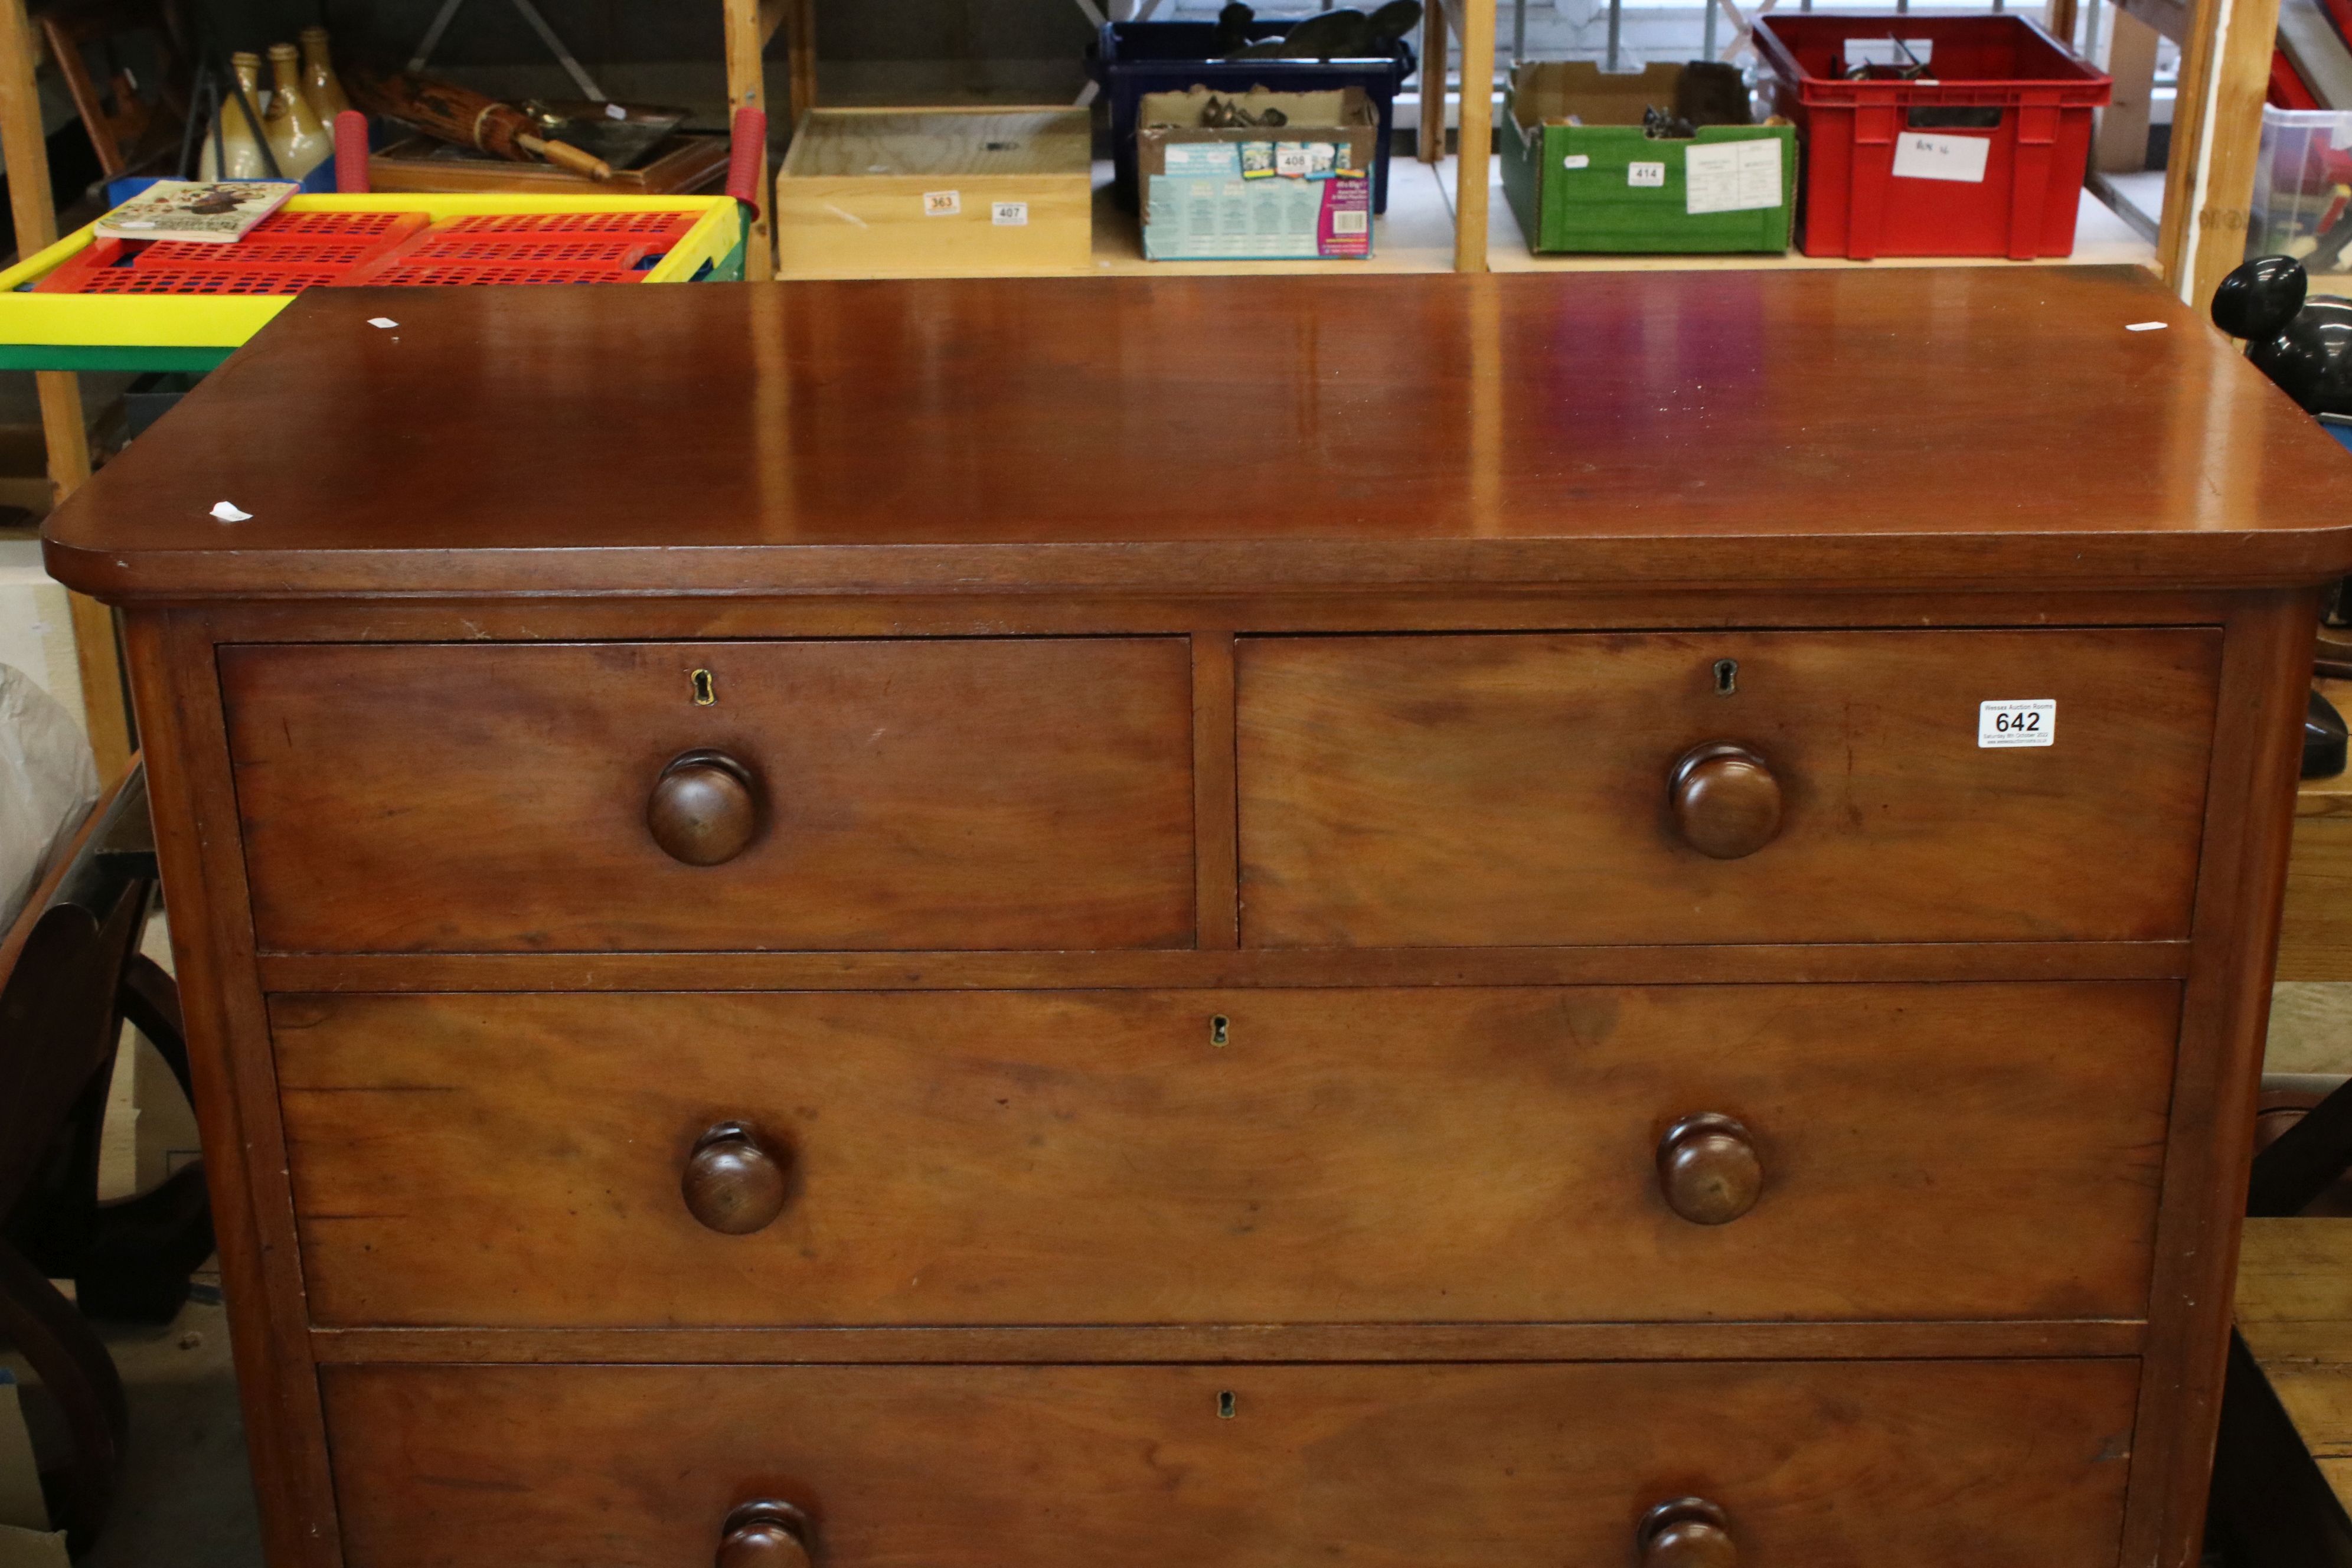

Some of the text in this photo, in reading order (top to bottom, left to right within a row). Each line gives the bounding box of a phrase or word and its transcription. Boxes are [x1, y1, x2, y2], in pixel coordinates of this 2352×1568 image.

[1285, 156, 1305, 167] 408
[1636, 169, 1657, 178] 414
[932, 197, 952, 207] 363
[999, 208, 1020, 217] 407
[1996, 712, 2040, 732] 642
